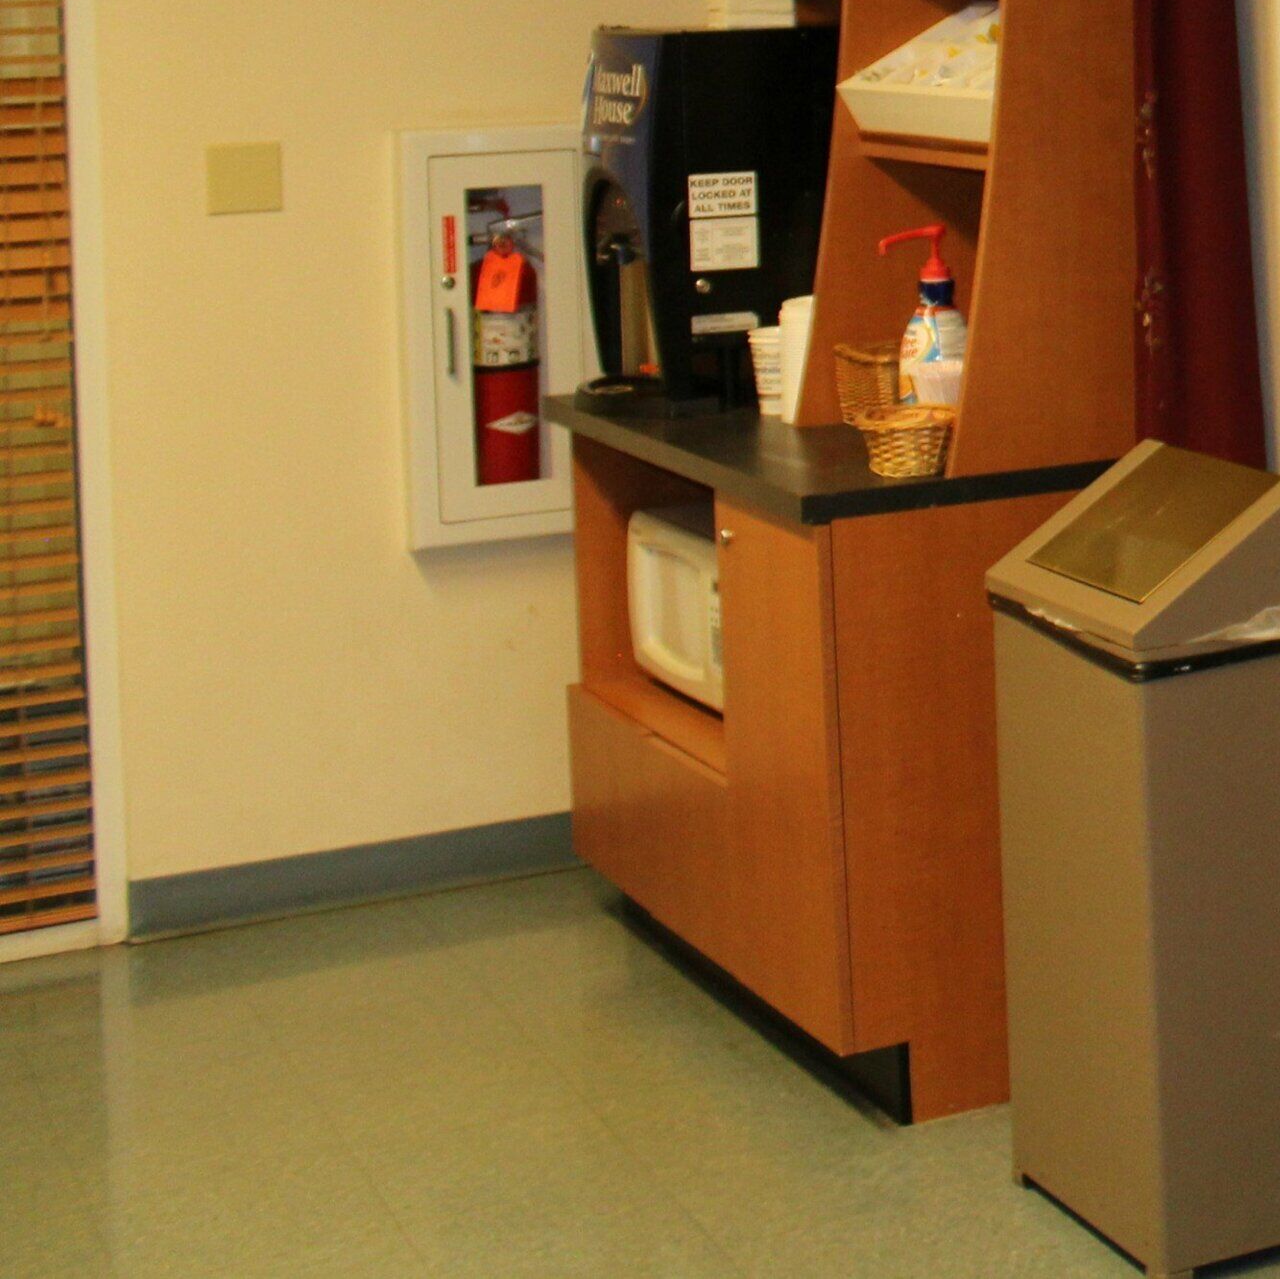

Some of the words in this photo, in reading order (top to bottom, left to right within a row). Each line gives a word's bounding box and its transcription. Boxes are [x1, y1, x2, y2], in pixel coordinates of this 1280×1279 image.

[689, 178, 719, 188] KEEP
[722, 176, 753, 186] DOOR
[691, 190, 736, 200] LOCKED
[739, 188, 752, 198] AT
[694, 203, 714, 212] ALL
[718, 201, 751, 211] TIMES
